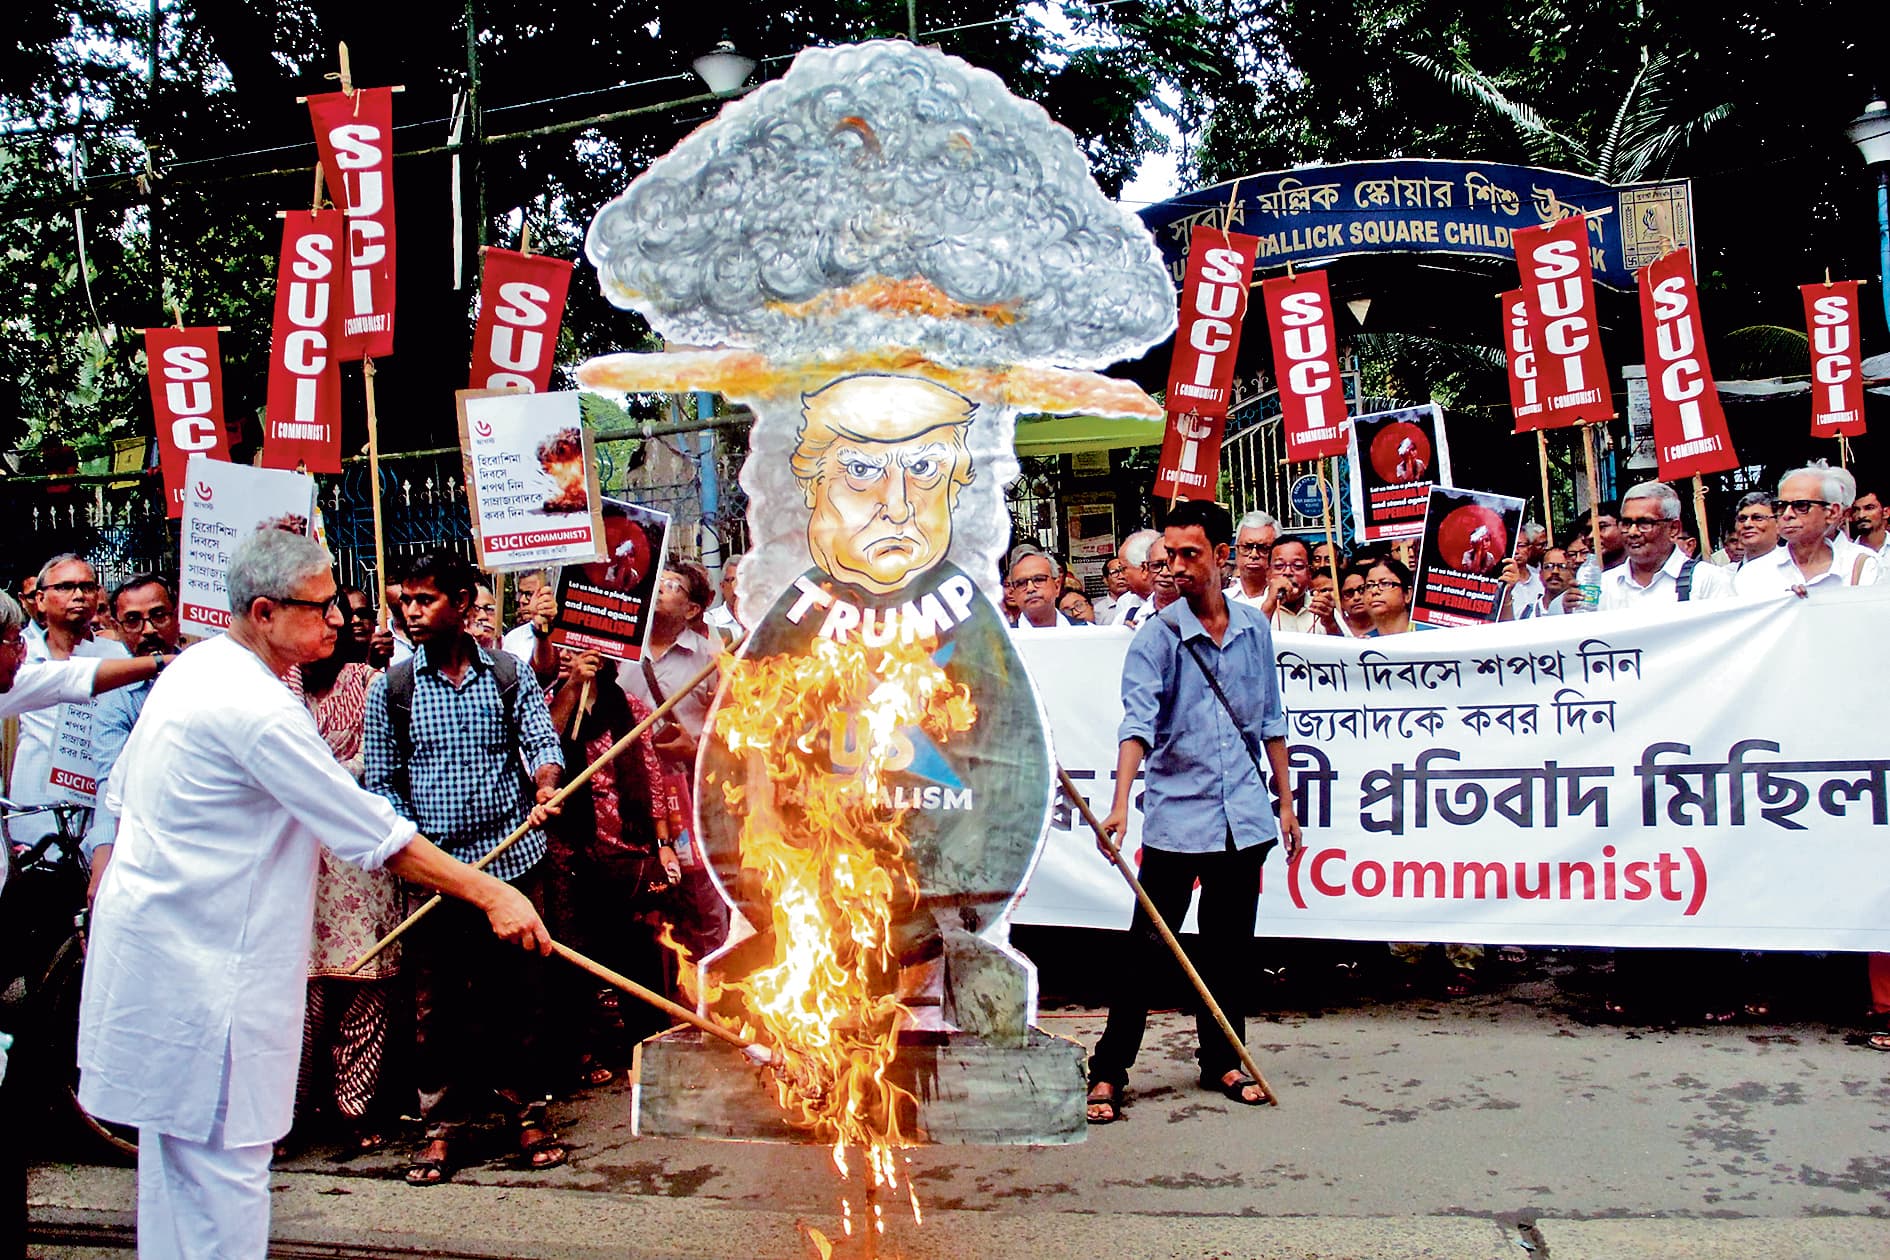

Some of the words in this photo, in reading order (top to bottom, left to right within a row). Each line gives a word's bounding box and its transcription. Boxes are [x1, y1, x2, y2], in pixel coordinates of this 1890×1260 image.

[328, 124, 386, 316] SUCI
[1256, 179, 1341, 219] মল্লিক
[1354, 176, 1455, 208] স্কোয়ার
[1464, 171, 1520, 216] শিশু
[1349, 220, 1440, 245] SQUARE
[283, 234, 333, 422] SUCI
[1190, 248, 1244, 387] SUCI
[1532, 239, 1590, 392] SUCI
[1280, 292, 1332, 429] SUCI
[1653, 276, 1705, 441] SUCI
[1813, 296, 1852, 412] SUCI
[163, 346, 218, 460] SUC
[491, 536, 523, 550] SUCI
[524, 530, 587, 546] (COMMUNIST)
[189, 606, 223, 624] SUCI
[565, 600, 582, 609] and
[583, 604, 606, 616] stand
[607, 610, 638, 623] against
[569, 580, 580, 588] Let
[609, 591, 631, 602] pledge
[785, 574, 975, 648] TRUMP
[1426, 584, 1442, 592] and
[1443, 586, 1466, 596] stand
[1466, 591, 1495, 601] against
[1276, 651, 1348, 693] শিমা
[1357, 650, 1461, 692] দিবসে
[1472, 649, 1566, 686] শপথ
[1577, 639, 1643, 682] নিন
[1457, 702, 1540, 736] কবর
[1551, 688, 1616, 734] দিন
[55, 771, 85, 789] SUCI
[880, 786, 973, 811] ALISM
[1360, 748, 1614, 836] প্রতিবাদ
[1634, 739, 1890, 831] মিছিল
[1287, 845, 1708, 916] (Communist)
